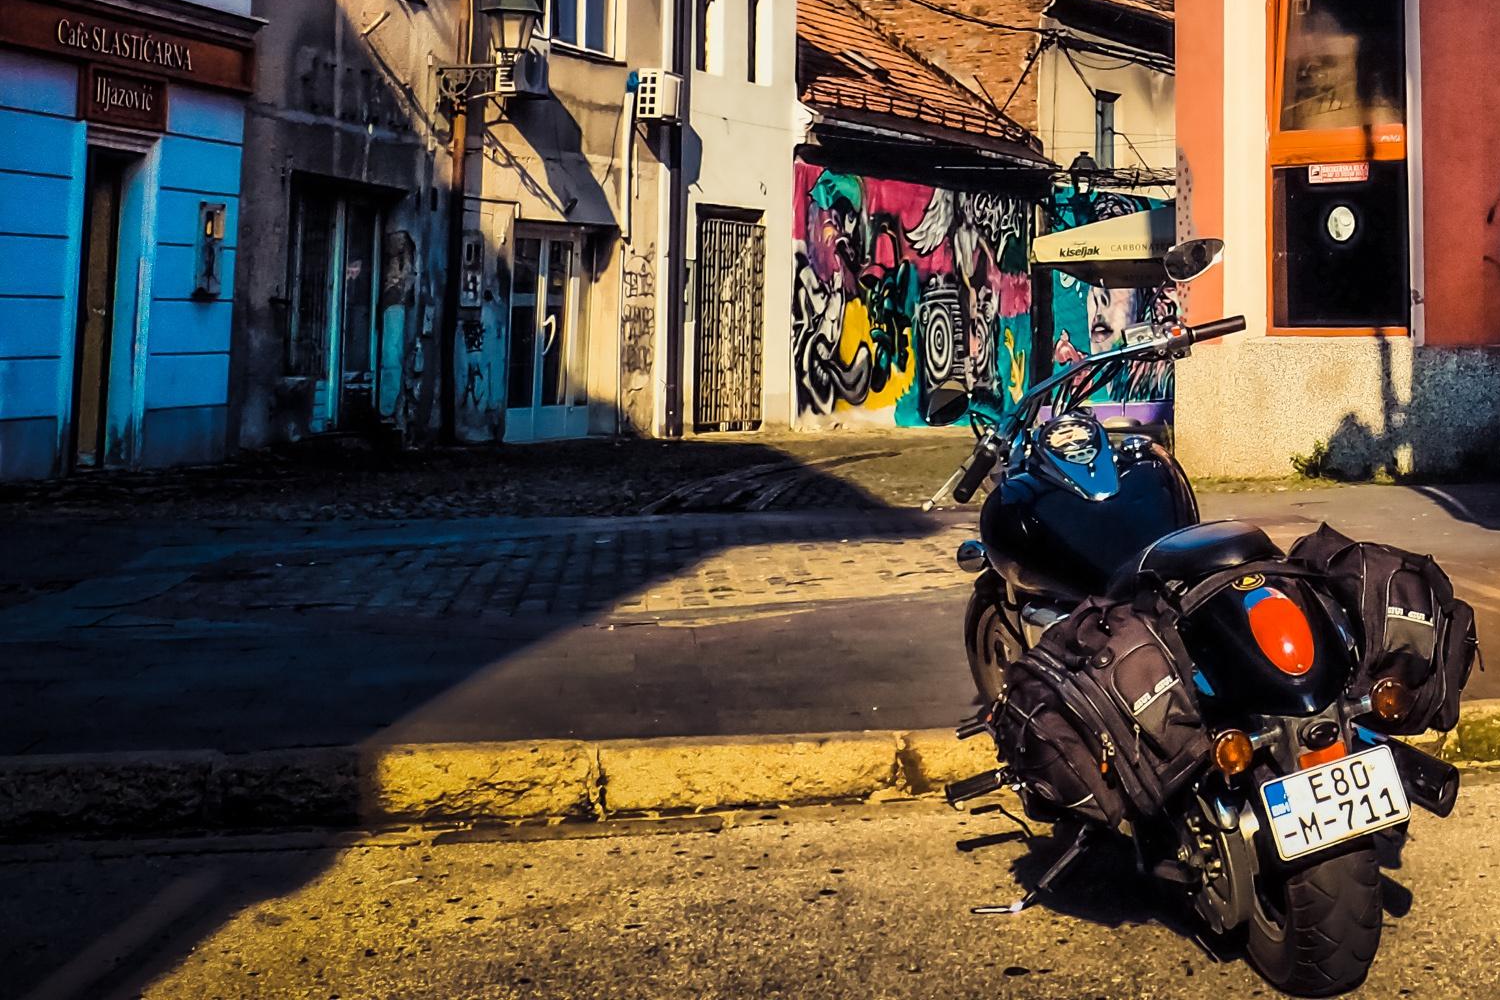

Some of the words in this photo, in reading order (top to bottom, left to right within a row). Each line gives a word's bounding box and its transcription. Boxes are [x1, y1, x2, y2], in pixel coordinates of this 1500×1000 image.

[57, 18, 88, 49] Cafe
[1059, 245, 1100, 258] kiseljak
[1307, 760, 1370, 804] E80
